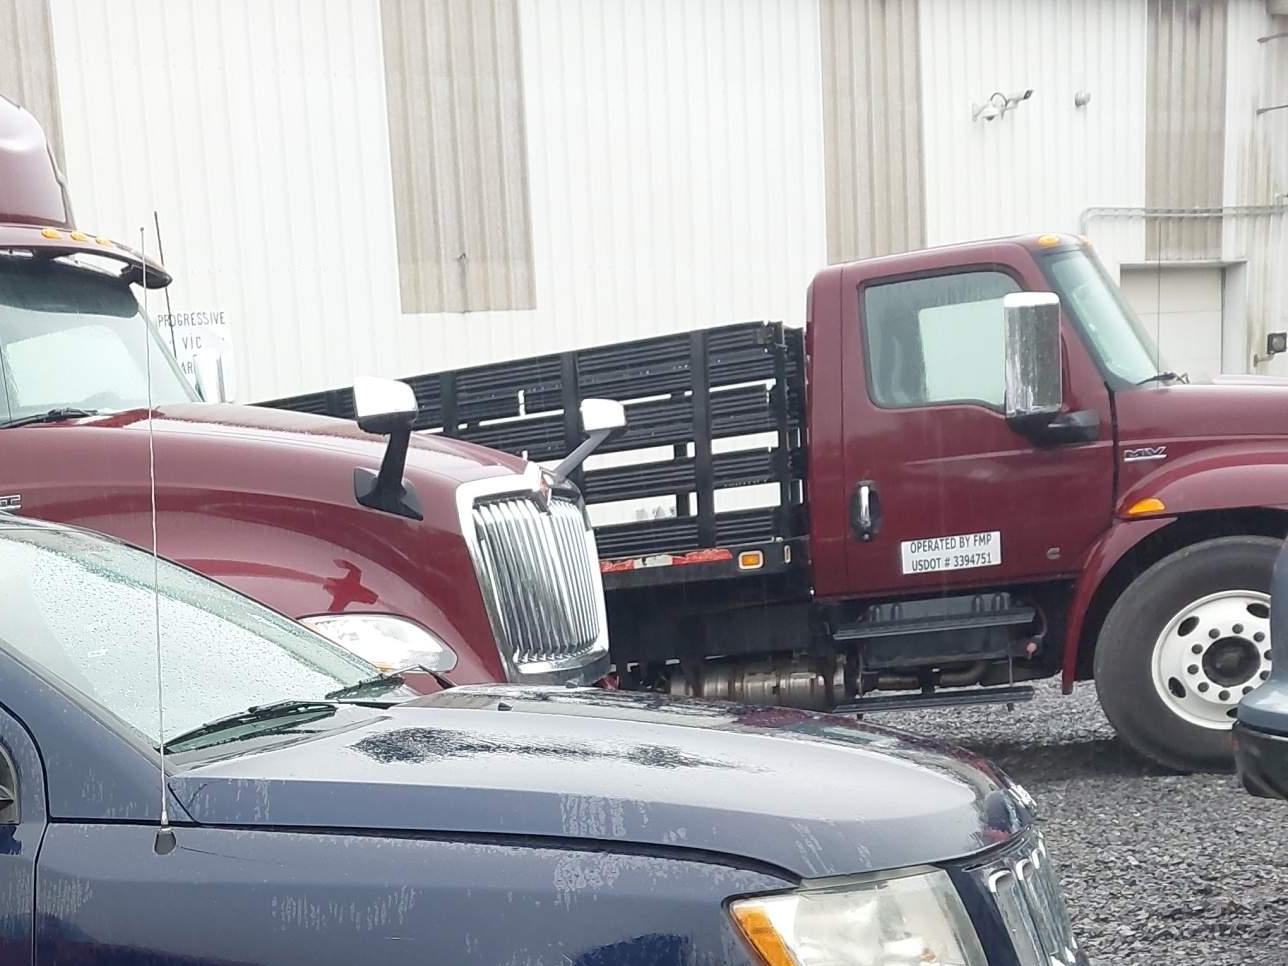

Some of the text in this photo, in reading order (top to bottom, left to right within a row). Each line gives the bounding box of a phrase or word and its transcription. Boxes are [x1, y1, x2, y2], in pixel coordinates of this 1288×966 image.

[158, 312, 226, 328] PROGRESSIVE
[910, 533, 992, 554] OPERATED BY FMP
[911, 552, 992, 571] USDOT # 3394751
